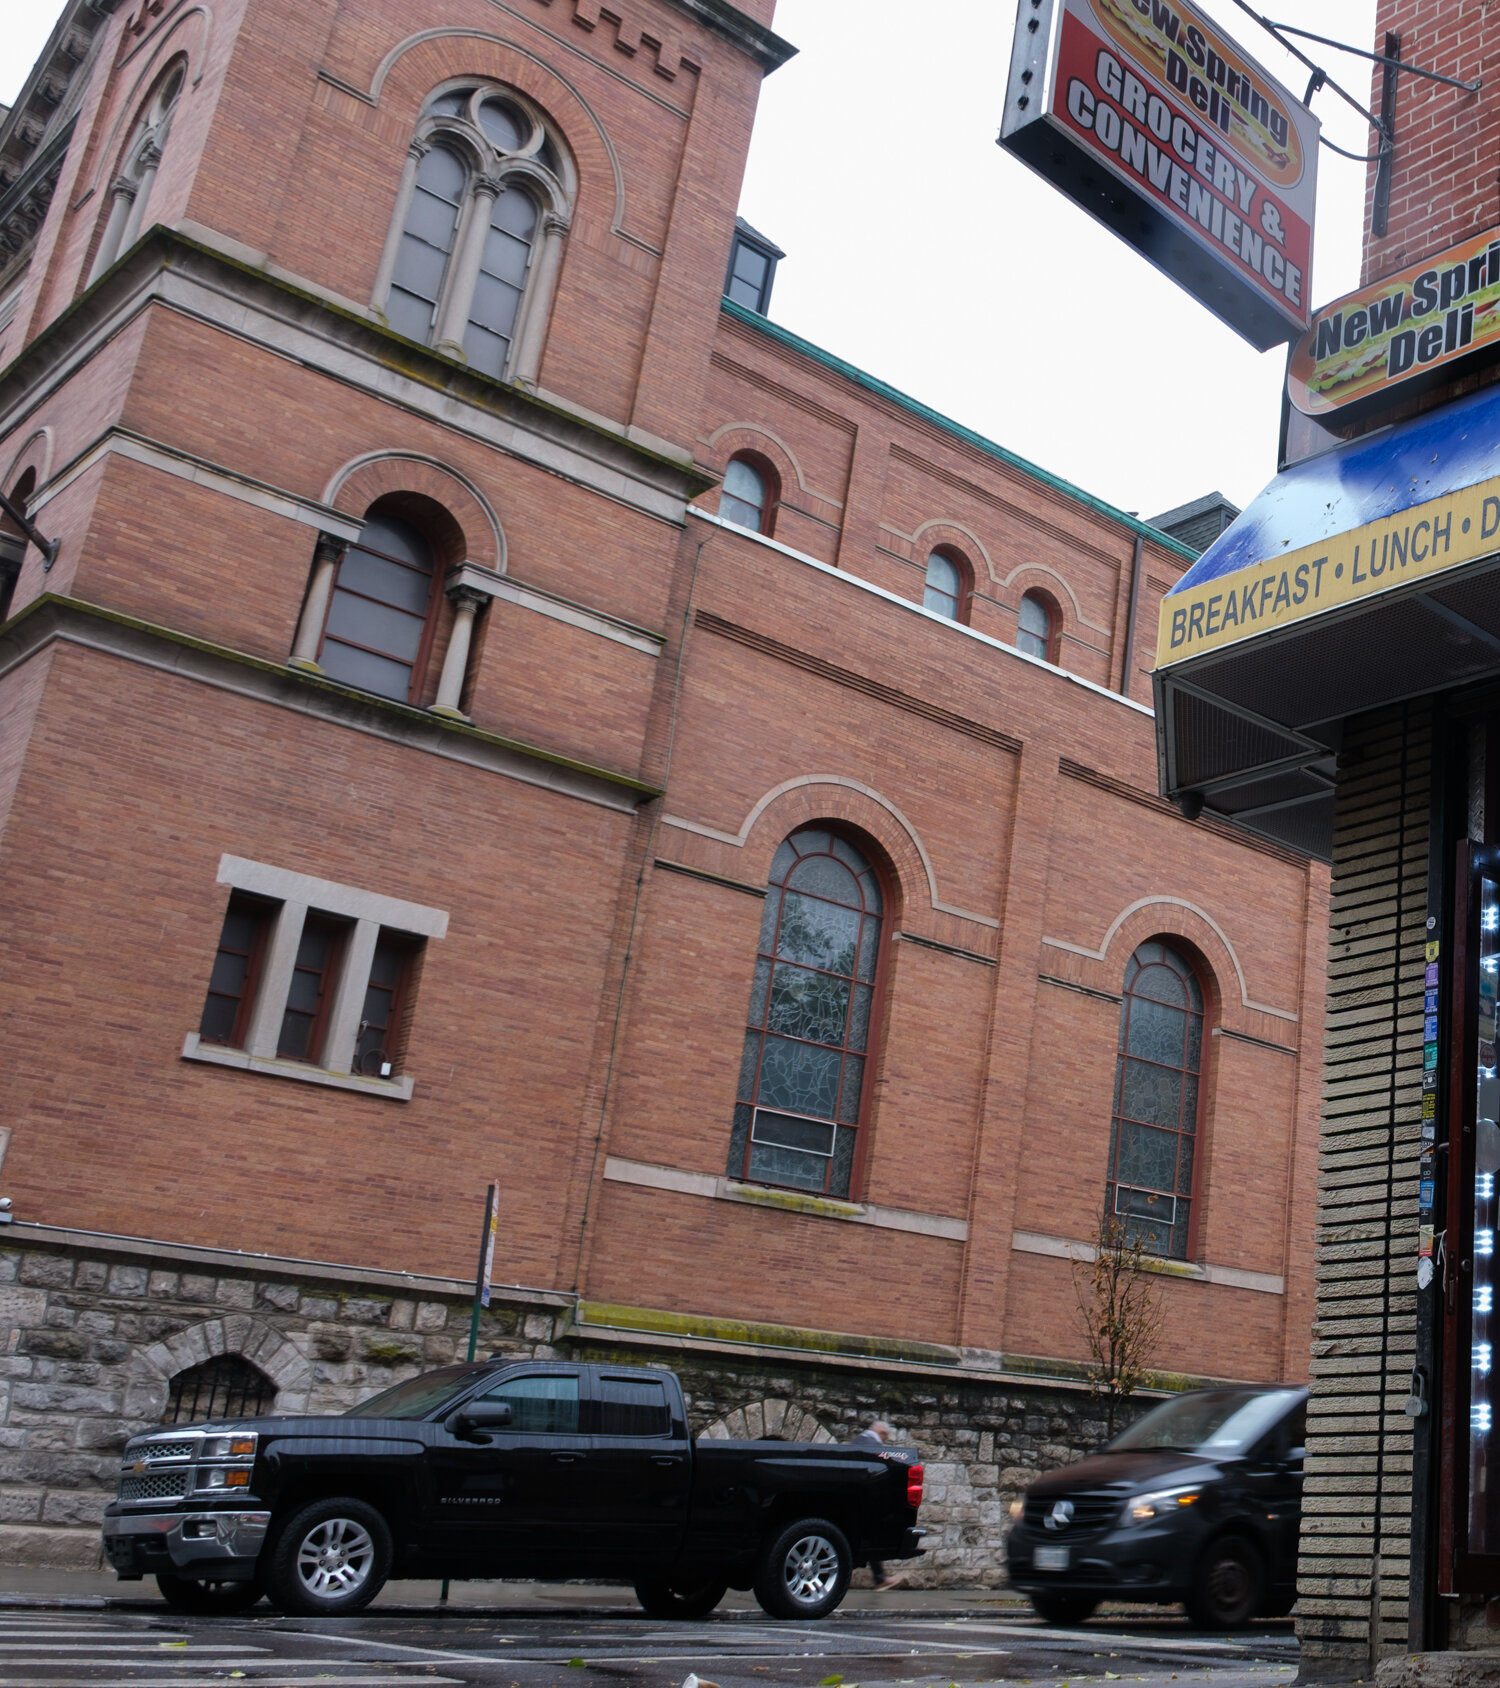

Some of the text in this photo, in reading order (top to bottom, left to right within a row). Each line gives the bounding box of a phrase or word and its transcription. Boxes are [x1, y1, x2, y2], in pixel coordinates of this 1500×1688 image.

[1130, 0, 1289, 148] ew Spring
[1164, 46, 1232, 137] Deli
[1066, 76, 1303, 308] CONVENIENCE
[1095, 48, 1288, 249] GROCERY &
[1315, 290, 1406, 362] New
[1386, 305, 1476, 379] Deli
[1170, 556, 1329, 649] BREAKFAST
[1351, 518, 1452, 586] LUNCH
